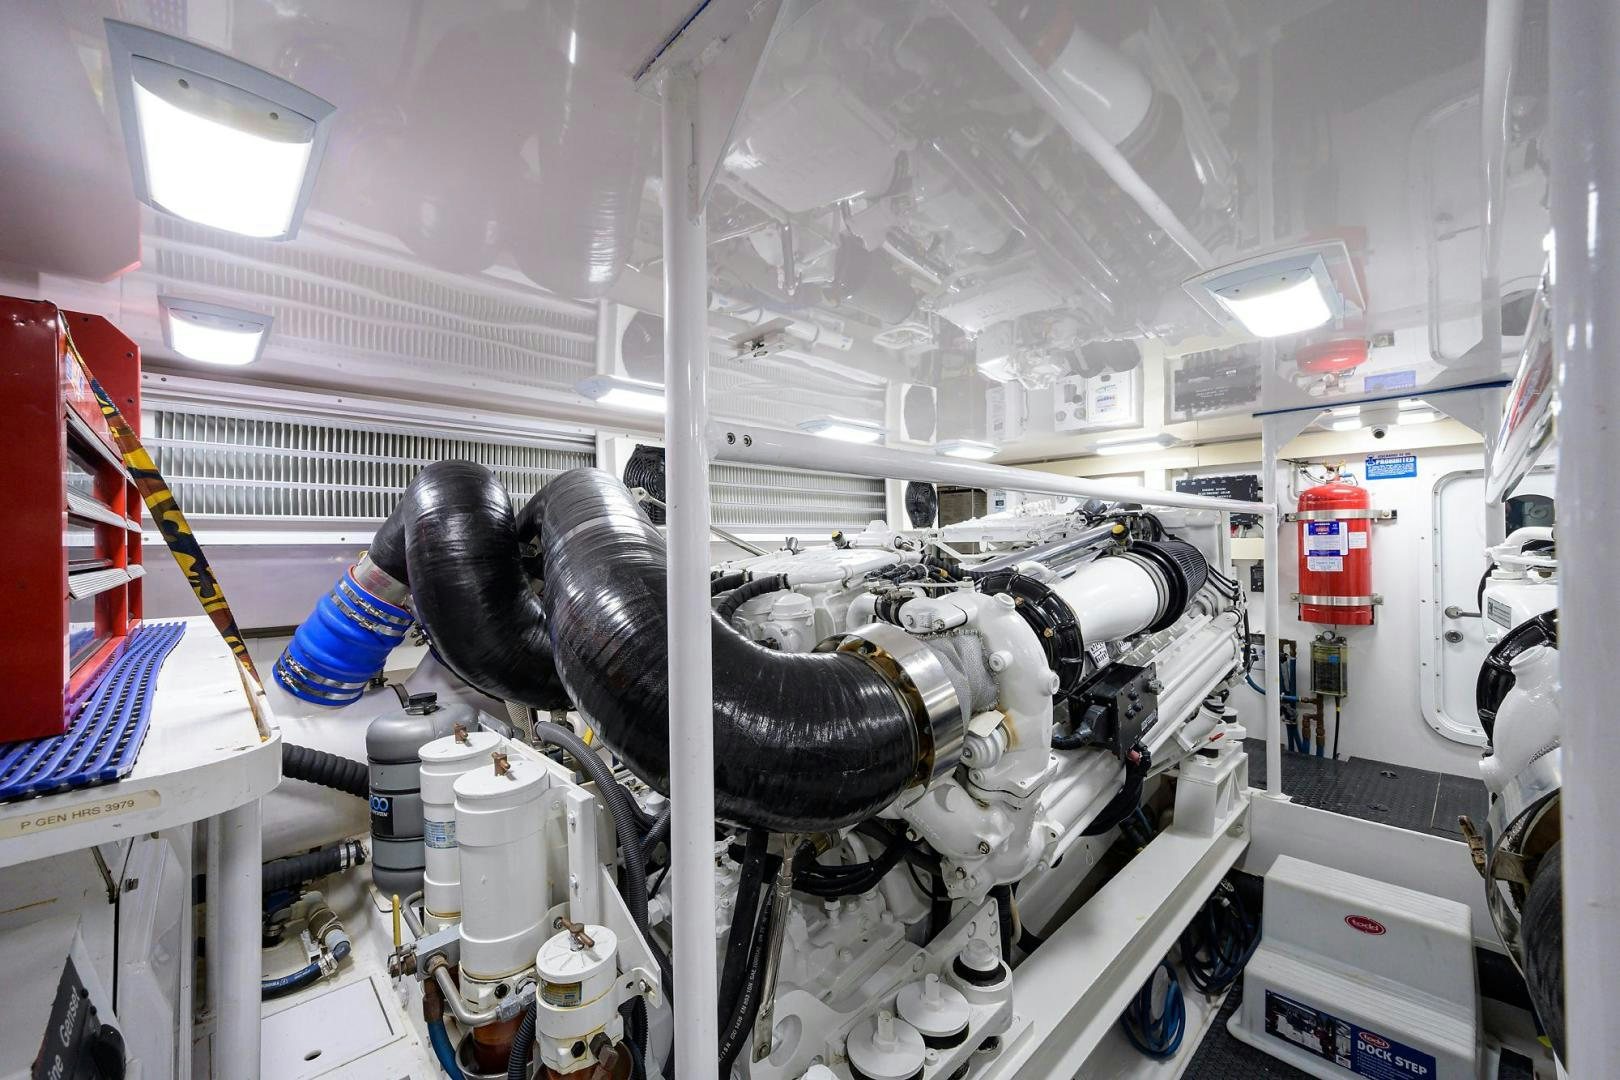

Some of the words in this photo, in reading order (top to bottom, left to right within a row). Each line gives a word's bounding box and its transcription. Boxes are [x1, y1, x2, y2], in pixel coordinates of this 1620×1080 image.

[21, 821, 31, 830] P
[35, 813, 67, 827] GEN
[71, 808, 100, 820] HRS
[104, 799, 135, 813] 3979
[60, 985, 80, 1048] Genset
[1357, 1040, 1393, 1063] DOCK
[1394, 1055, 1428, 1075] STEP
